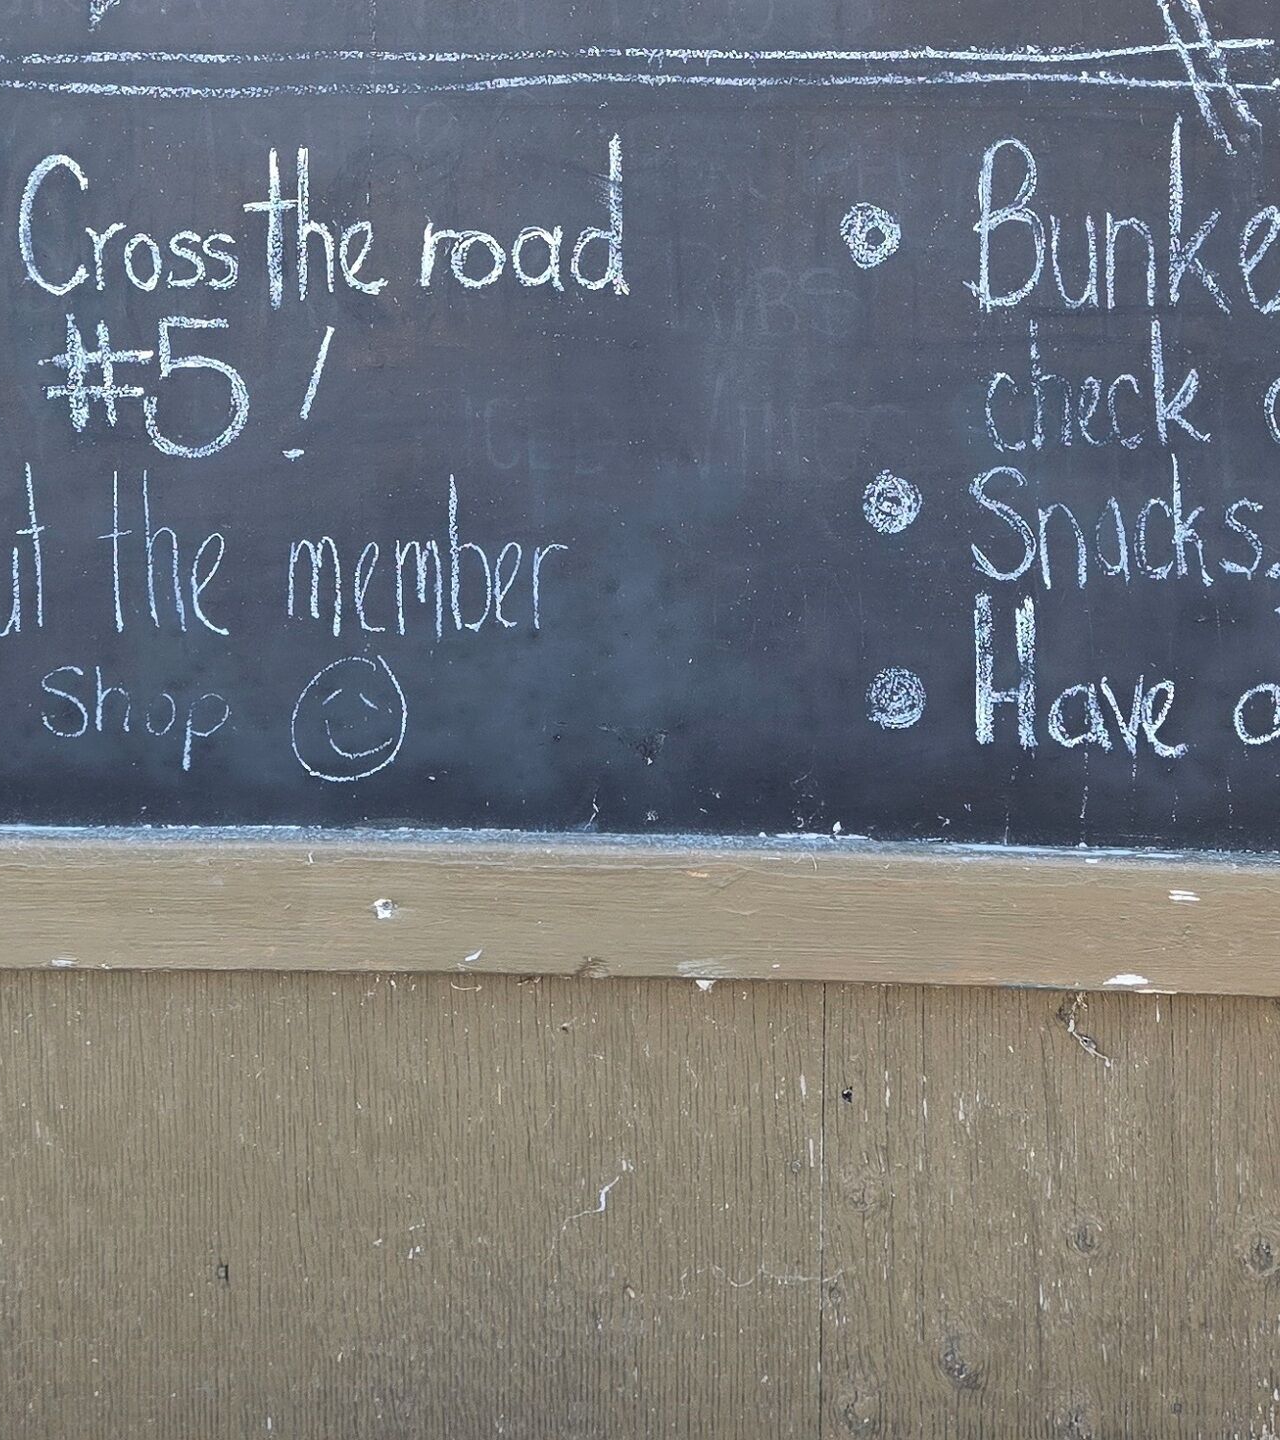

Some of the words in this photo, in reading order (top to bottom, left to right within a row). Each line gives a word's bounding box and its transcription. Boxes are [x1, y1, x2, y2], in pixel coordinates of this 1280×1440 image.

[18, 153, 239, 296] Cross
[242, 145, 389, 311] the
[420, 132, 631, 297] road
[983, 318, 1212, 453] check
[96, 468, 230, 636] the
[286, 473, 569, 642] member
[41, 665, 232, 771] Shop
[973, 592, 1189, 760] Have
